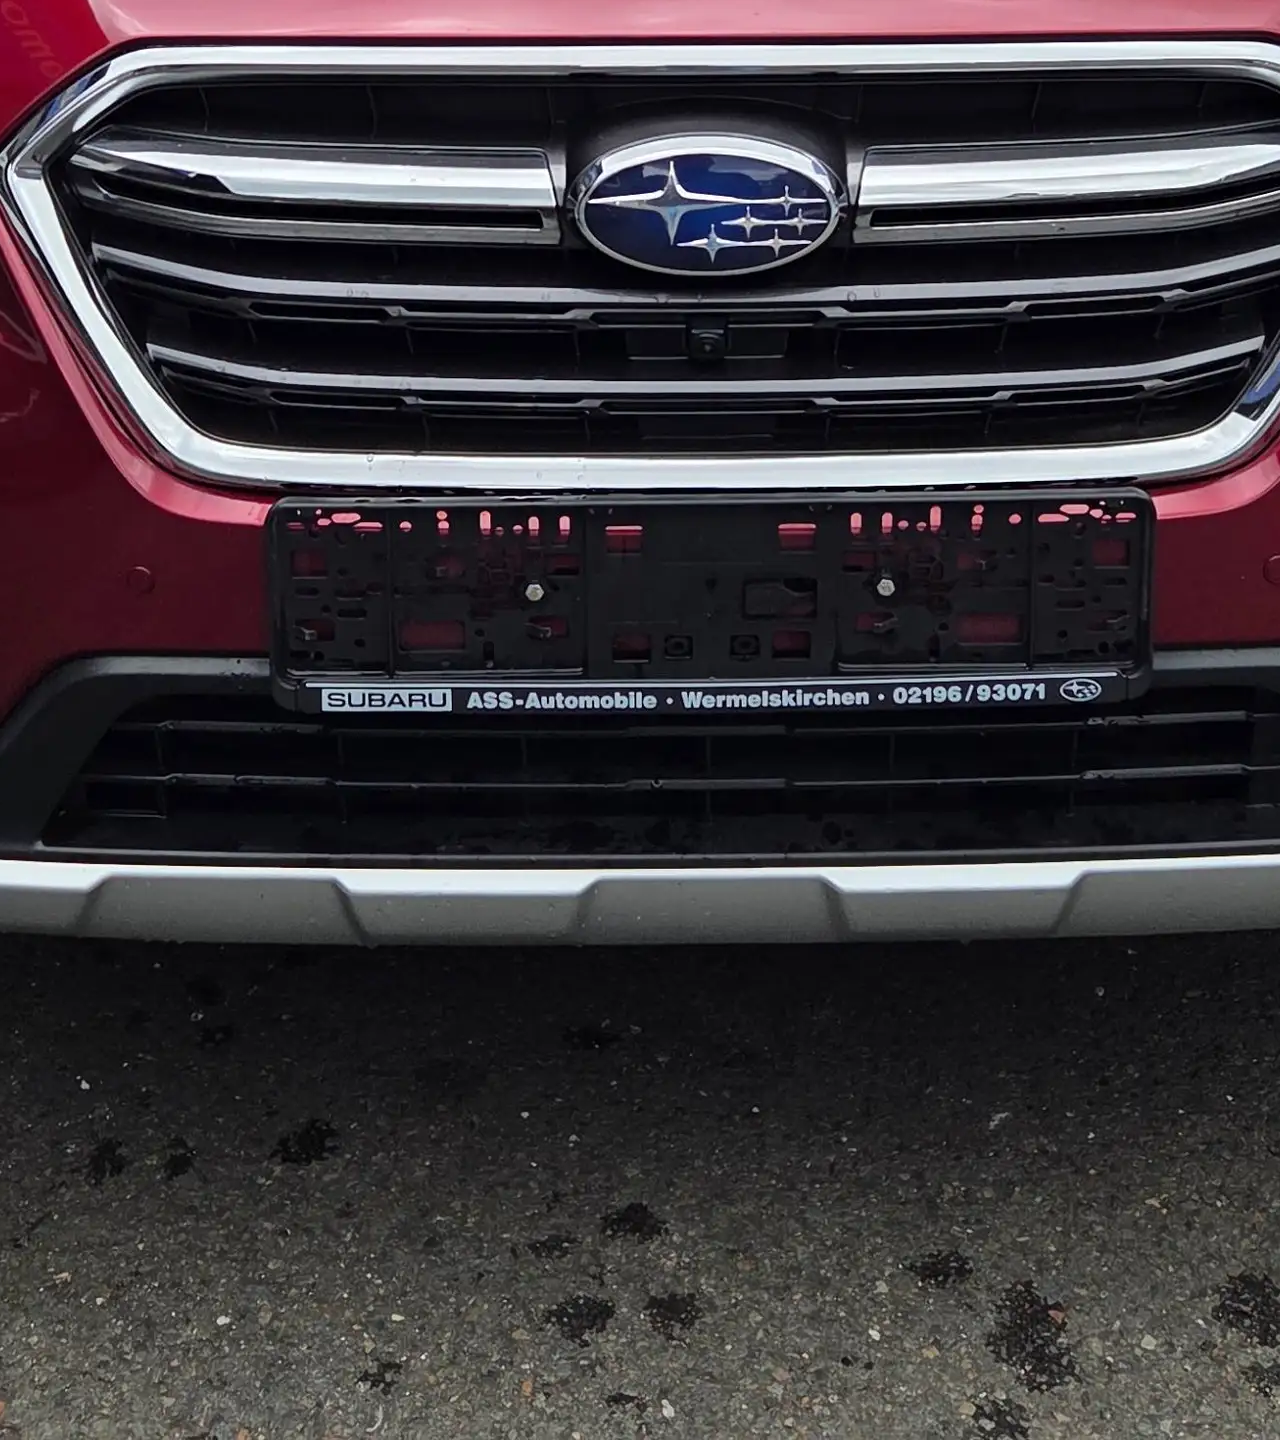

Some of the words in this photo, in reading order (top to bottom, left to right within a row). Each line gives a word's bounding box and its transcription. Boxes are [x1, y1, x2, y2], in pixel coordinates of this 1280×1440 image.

[326, 692, 448, 708] SUBARU
[467, 691, 657, 710] ASS-Automobile
[680, 688, 870, 709] Wermelskirchen
[892, 682, 1046, 705] 02196/93071
